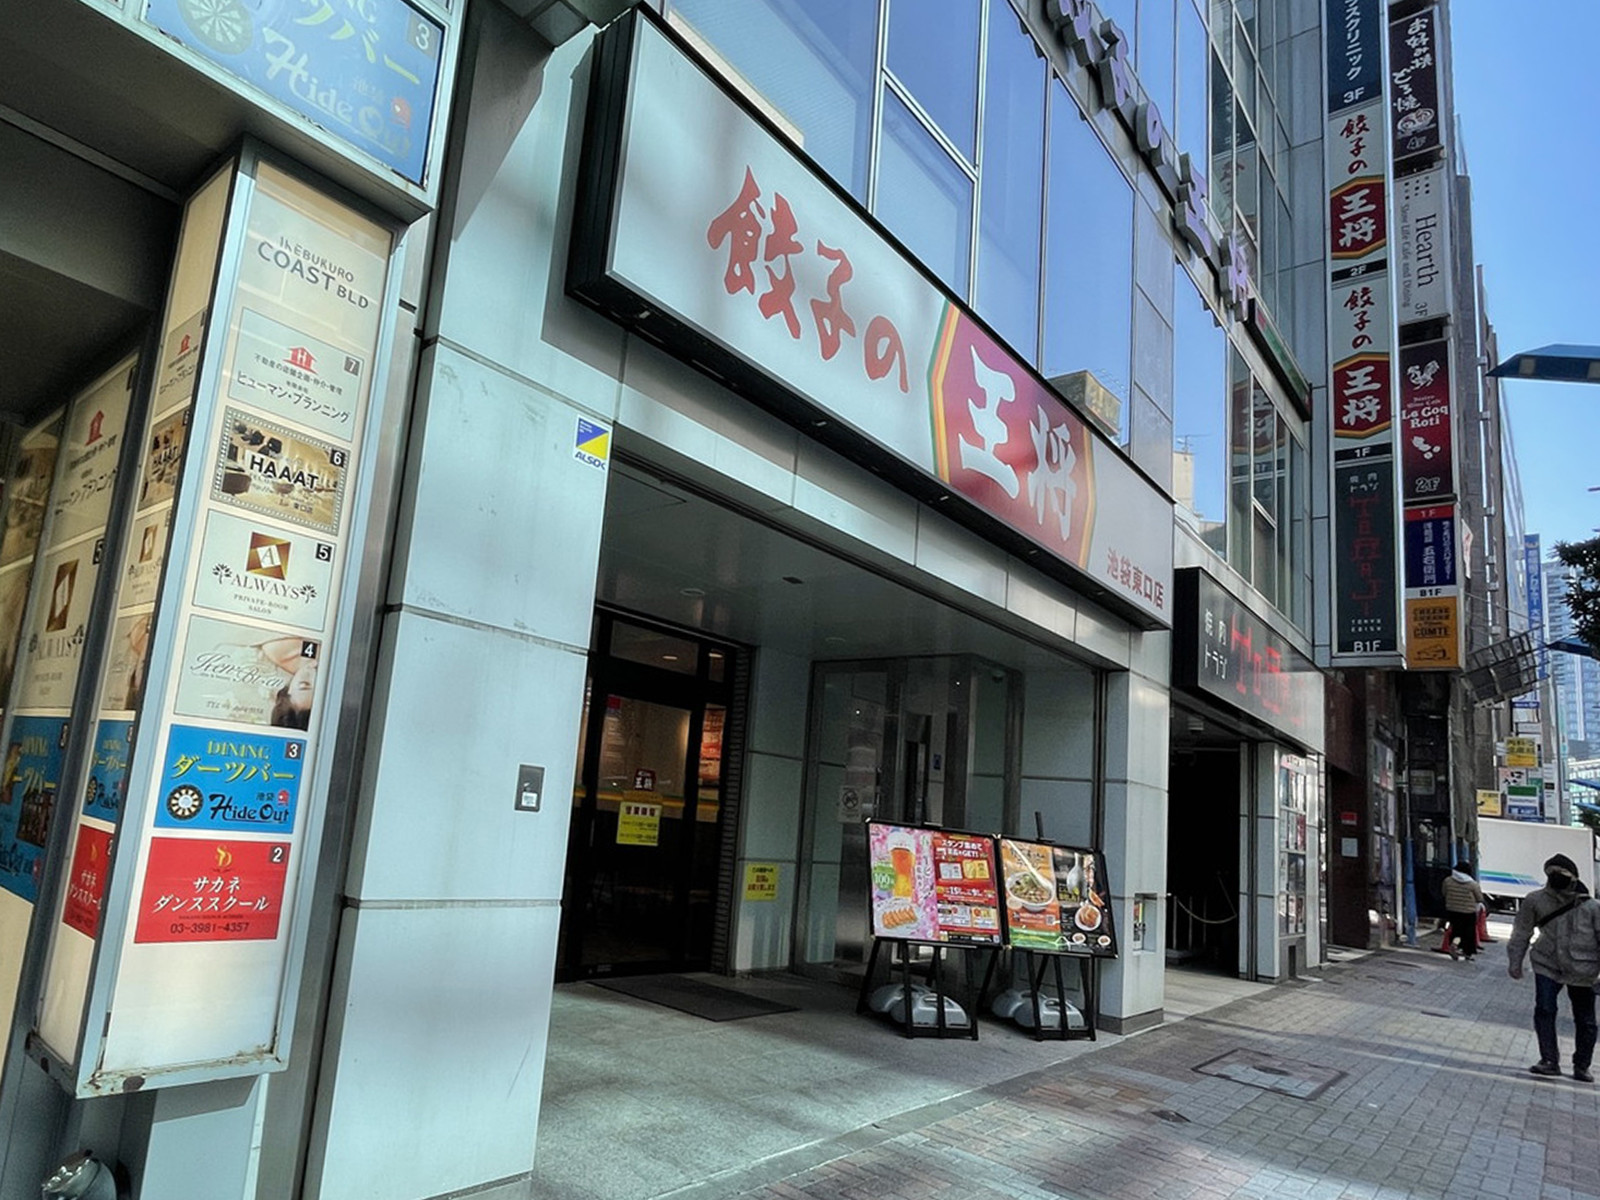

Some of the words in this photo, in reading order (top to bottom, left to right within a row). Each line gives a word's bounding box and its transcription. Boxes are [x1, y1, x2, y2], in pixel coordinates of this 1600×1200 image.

[415, 23, 430, 50] 3
[1343, 87, 1365, 103] 3F
[1338, 188, 1376, 247] 王将
[1415, 213, 1439, 288] Hearth
[258, 241, 336, 290] COAST
[337, 284, 369, 309] BLD
[707, 165, 910, 394] 餃子の
[1350, 264, 1366, 276] 2F
[1343, 286, 1375, 350] 餃子の
[1415, 302, 1429, 316] 3F
[348, 359, 357, 373] 7
[1342, 365, 1381, 426] 王将
[958, 344, 1078, 542] 王将
[1354, 447, 1371, 458] 1F
[333, 452, 342, 465] 6
[575, 451, 606, 471] ALSOK
[250, 455, 319, 489] HAAAT
[1415, 476, 1441, 493] 2F
[1421, 509, 1436, 518] 1F
[318, 545, 331, 560] 5
[231, 572, 300, 600] ALWAYS
[1106, 547, 1164, 610] 池袋東口店
[1420, 588, 1442, 597] B1F
[304, 643, 315, 657] 4
[1353, 640, 1381, 653] B1F
[207, 740, 270, 759] DINING
[288, 743, 298, 758] 3
[171, 754, 296, 783] ダーツバー
[209, 794, 257, 822] Hide
[259, 804, 289, 822] Out
[272, 847, 283, 863] 2
[193, 876, 241, 894] サカネ
[152, 894, 270, 913] ダンススクール
